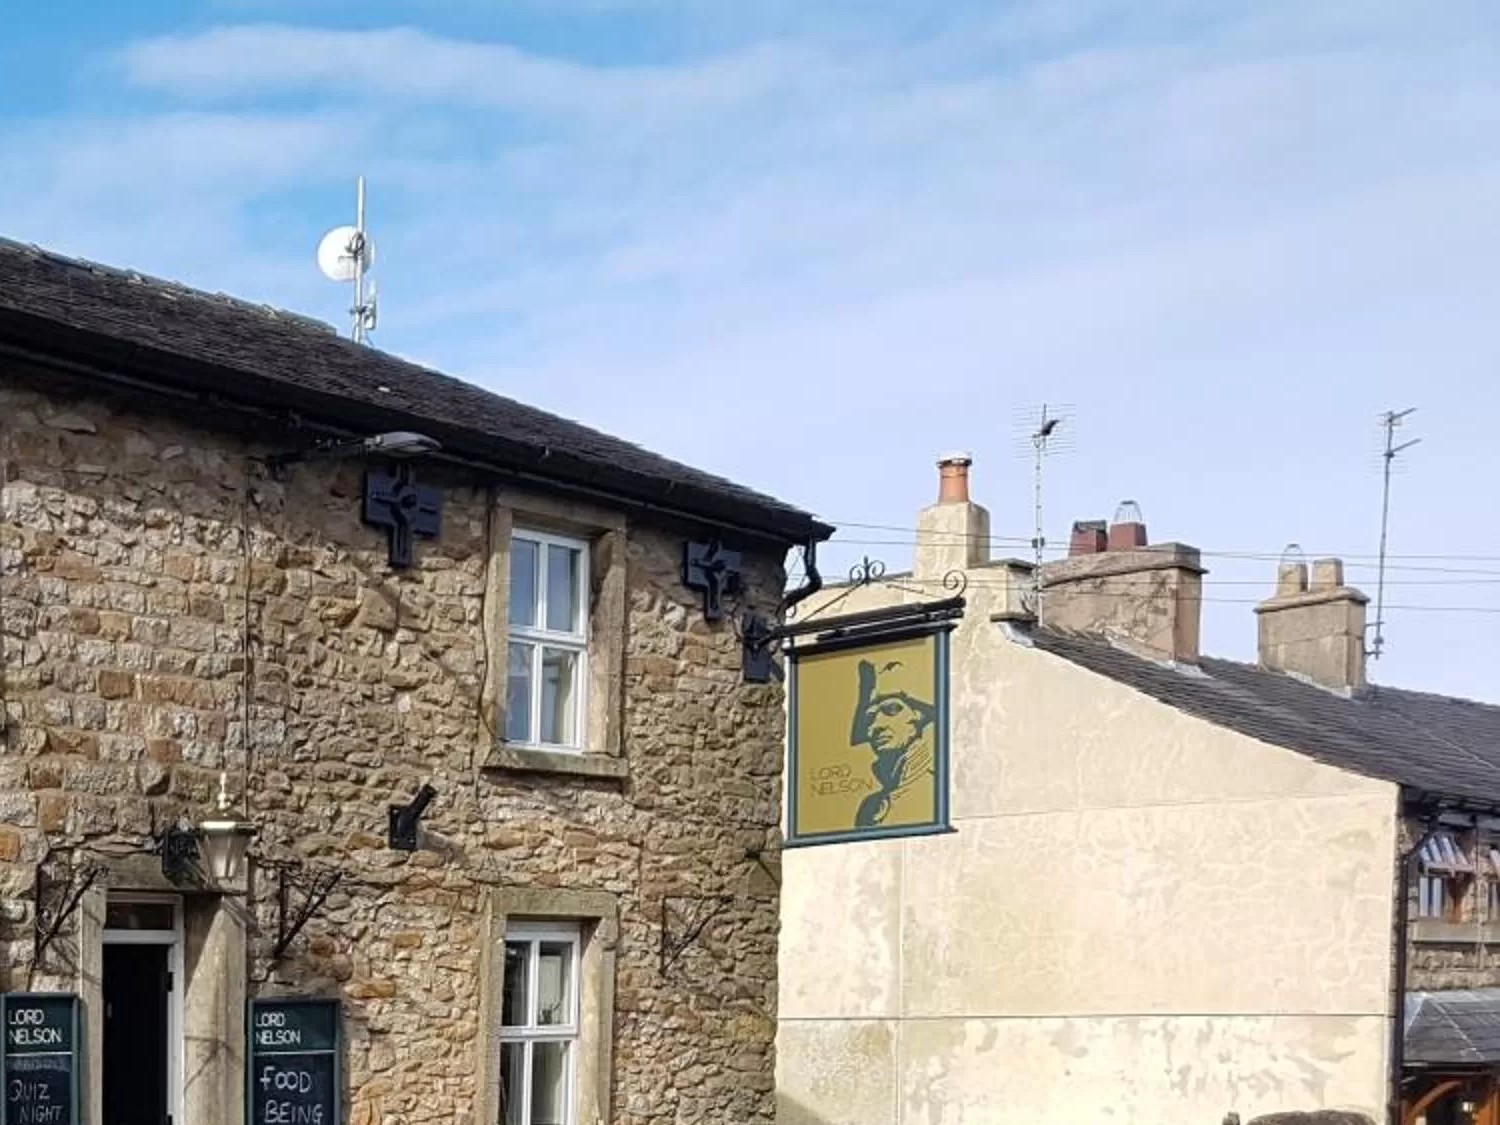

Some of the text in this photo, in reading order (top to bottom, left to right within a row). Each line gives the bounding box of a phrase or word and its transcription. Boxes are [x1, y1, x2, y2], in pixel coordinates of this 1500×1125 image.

[810, 763, 853, 781] LORD
[810, 777, 874, 796] NELSON
[8, 1009, 44, 1025] LORD
[256, 1012, 285, 1027] LORD
[8, 1028, 62, 1045] NELSON
[256, 1030, 301, 1045] NELSON
[260, 1066, 311, 1093] FOOD
[8, 1079, 50, 1102] QUIZ
[19, 1104, 63, 1124] NIGHT
